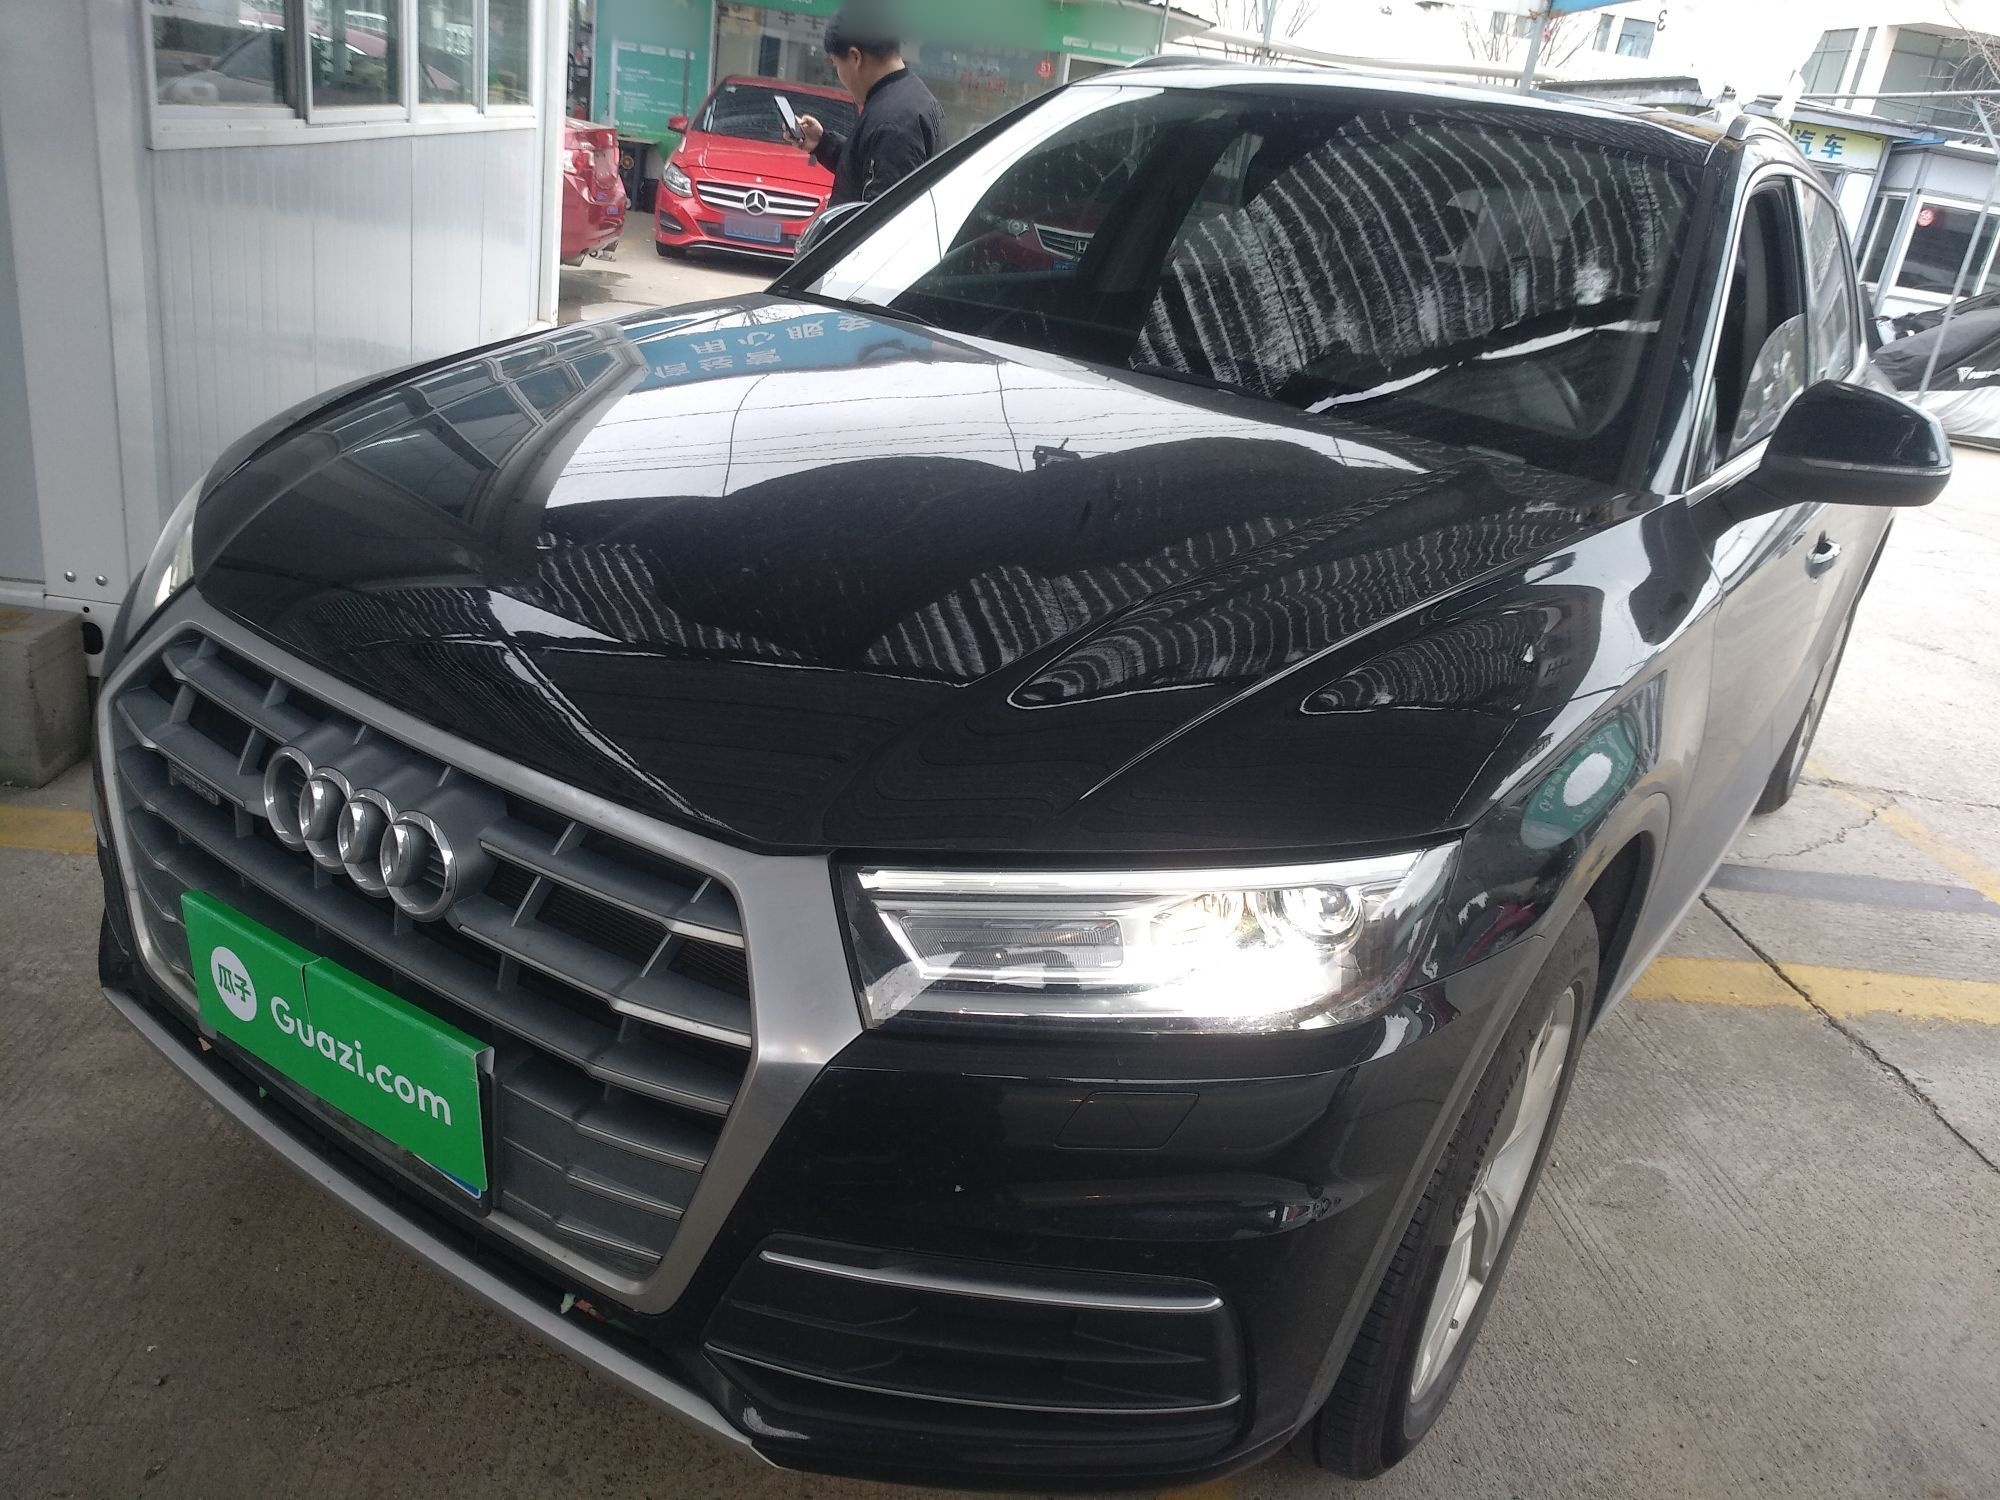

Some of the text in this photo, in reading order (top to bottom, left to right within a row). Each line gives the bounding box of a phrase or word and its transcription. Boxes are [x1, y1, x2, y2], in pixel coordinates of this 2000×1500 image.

[1794, 129, 1847, 159] 汽车
[217, 962, 452, 1127] 瓜子 Guazi.com
